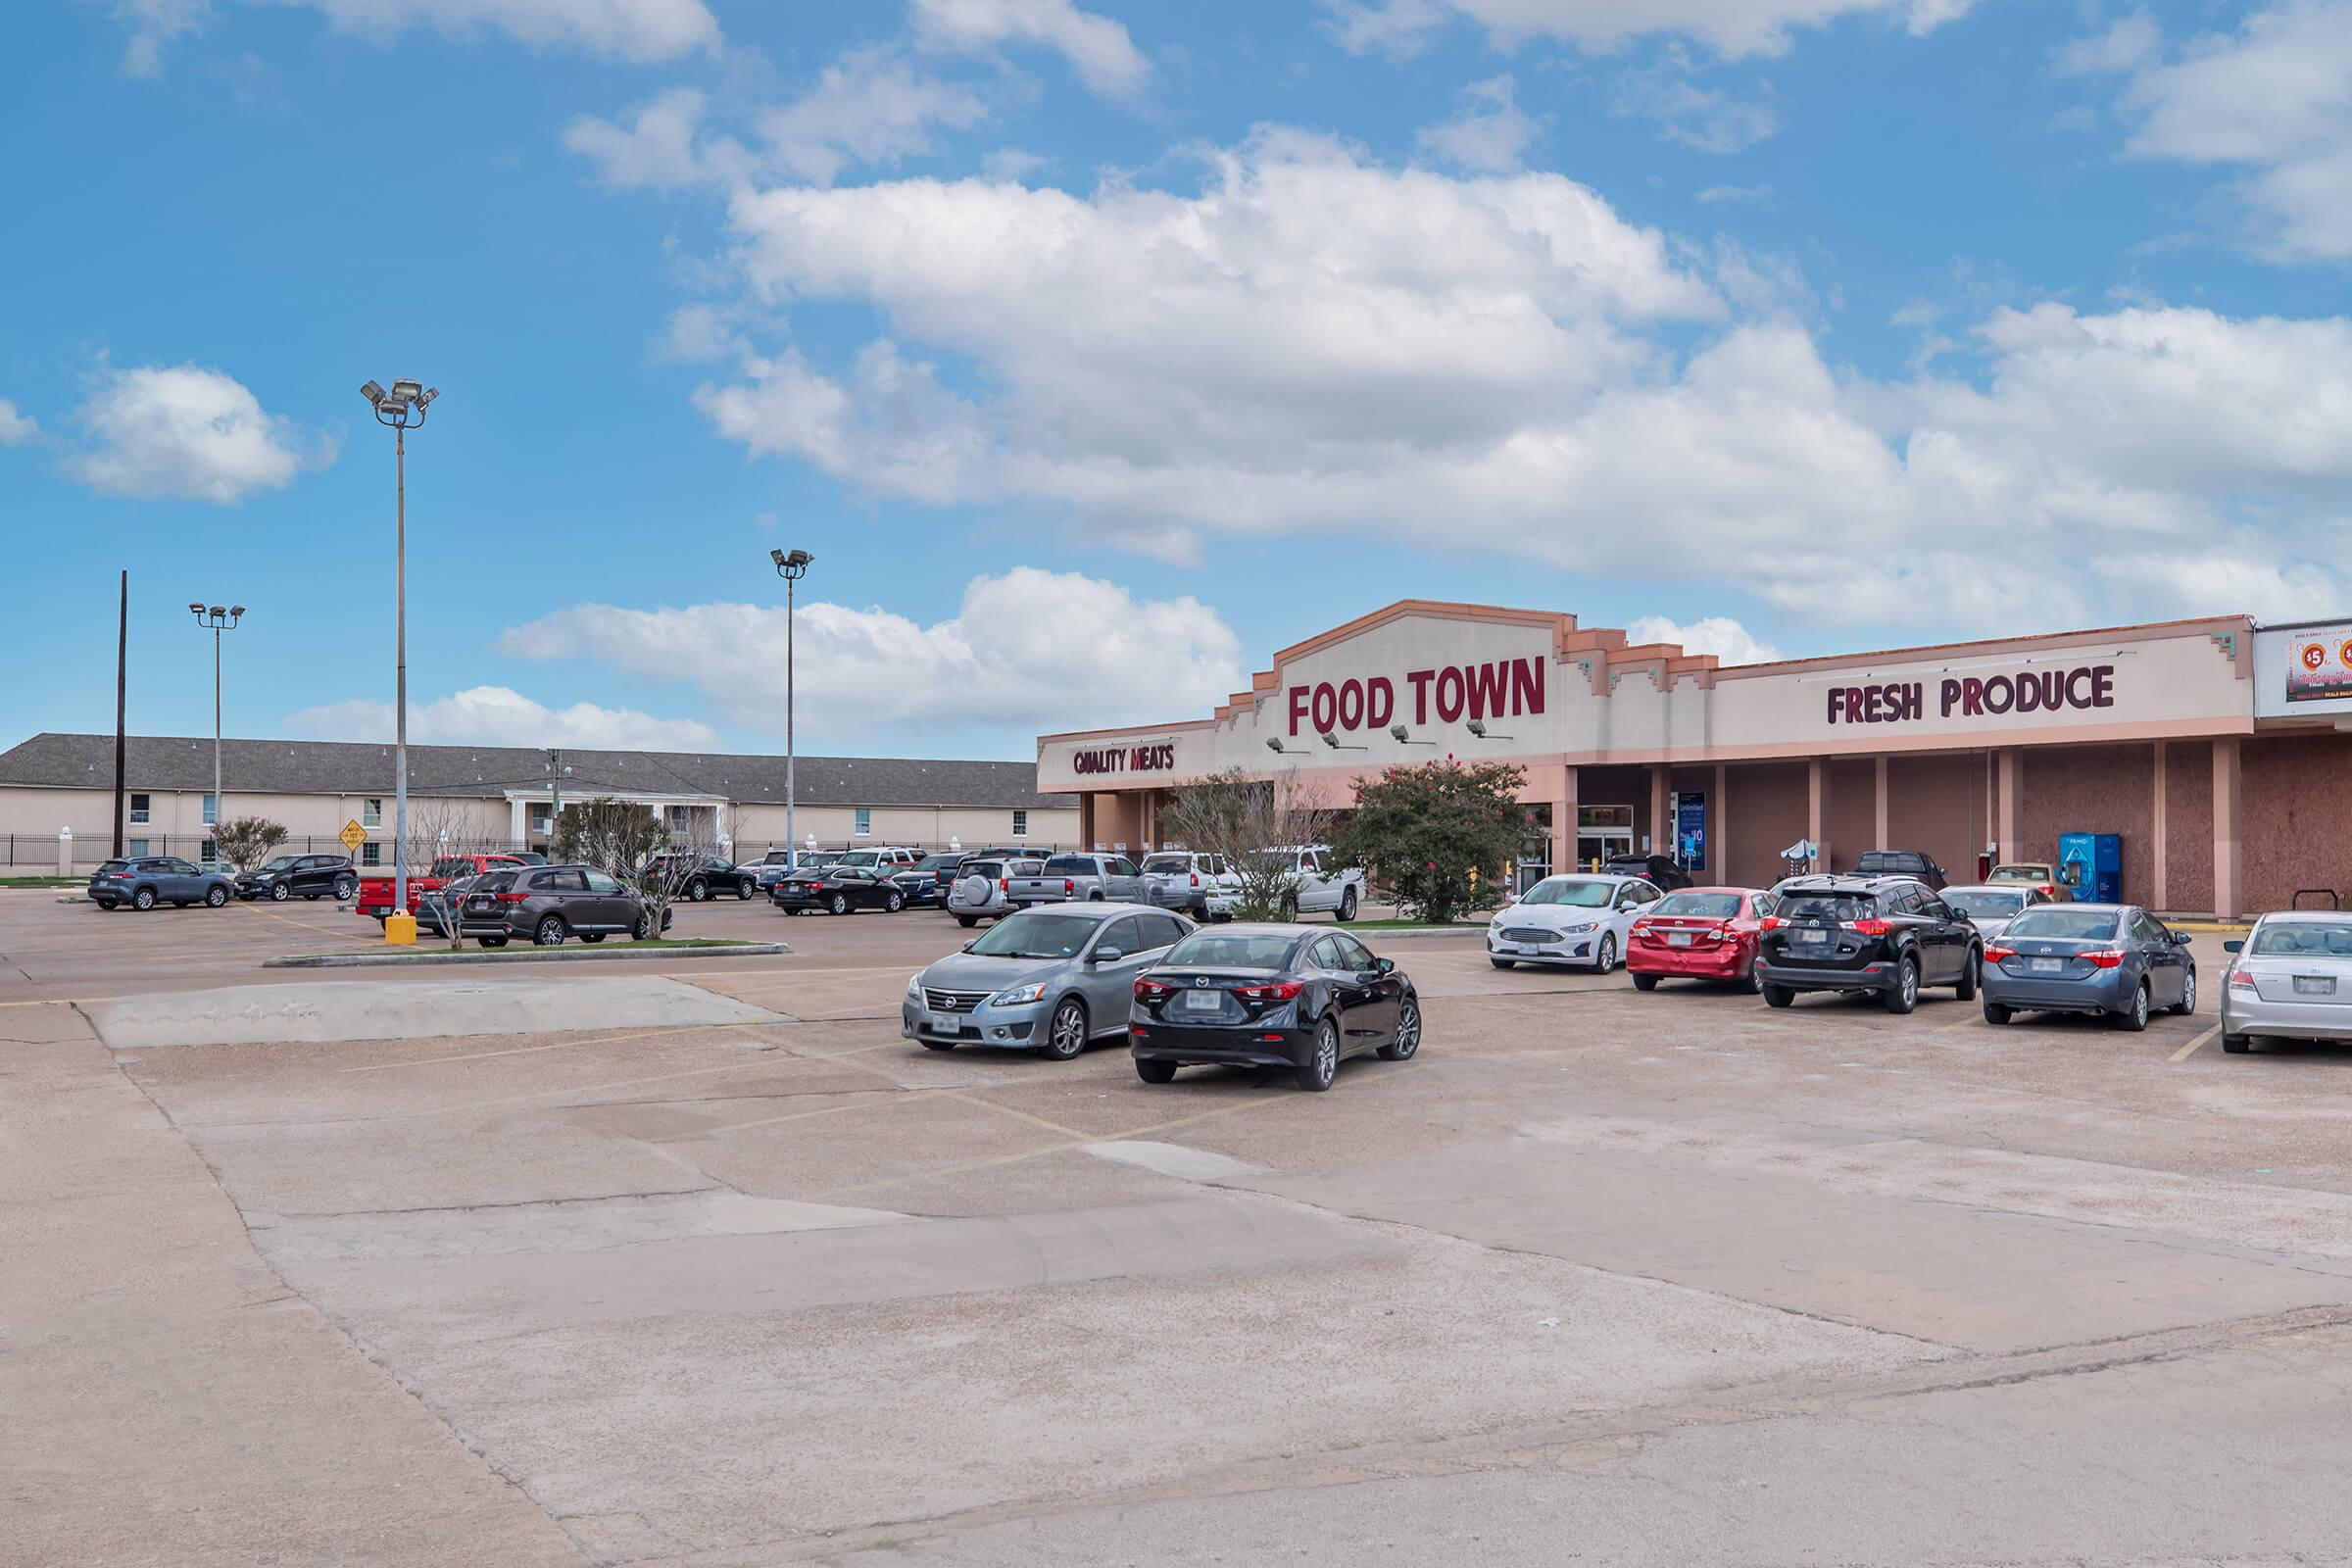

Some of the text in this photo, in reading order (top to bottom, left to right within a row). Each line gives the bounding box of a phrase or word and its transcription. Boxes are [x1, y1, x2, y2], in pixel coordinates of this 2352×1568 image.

[2307, 651, 2321, 664] $5
[1289, 656, 1544, 737] FOOD TOWN
[1828, 665, 2114, 724] FRESH PRODUCE
[1074, 744, 1174, 774] QUALITY MEATS
